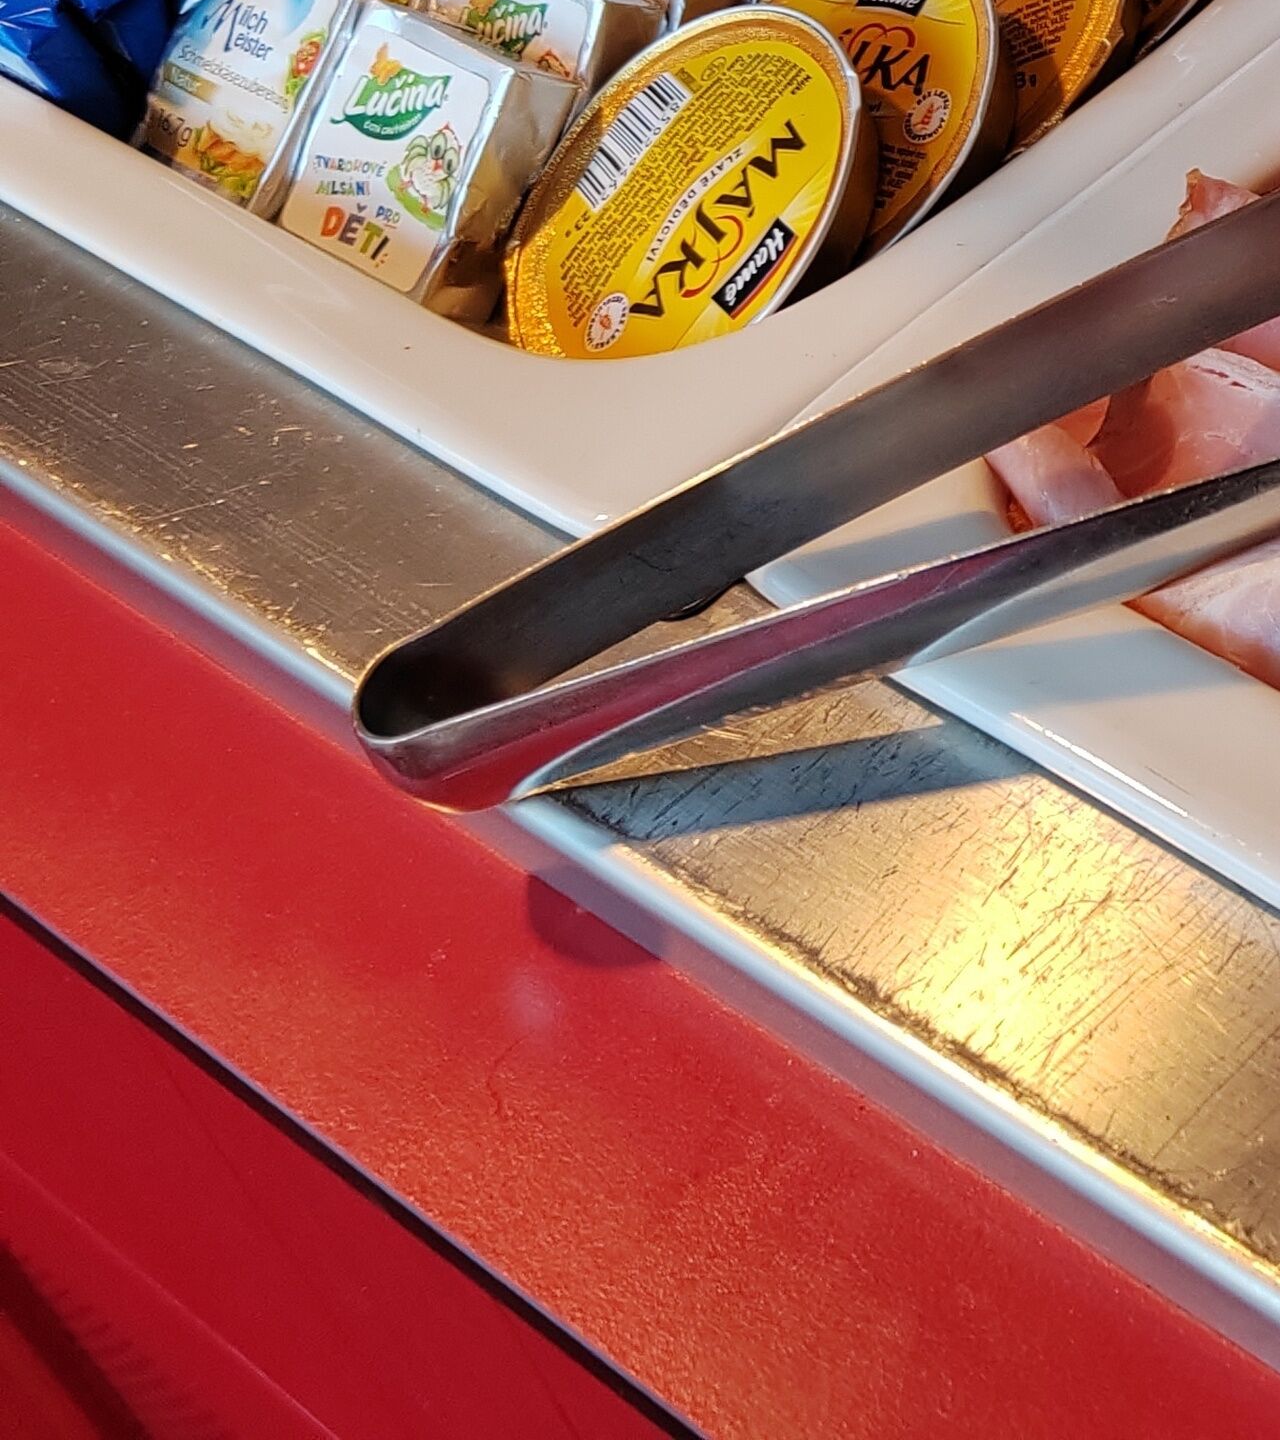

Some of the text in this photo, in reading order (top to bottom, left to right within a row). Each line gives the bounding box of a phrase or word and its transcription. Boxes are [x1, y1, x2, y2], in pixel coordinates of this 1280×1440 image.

[843, 28, 932, 97] JKA
[343, 74, 446, 118] Lučina
[315, 155, 386, 177] TVAROHOVÉ
[700, 148, 744, 188] ZLATÉ
[375, 206, 400, 225] PRO
[629, 119, 806, 318] MÁJKA
[724, 227, 786, 307] Hamé
